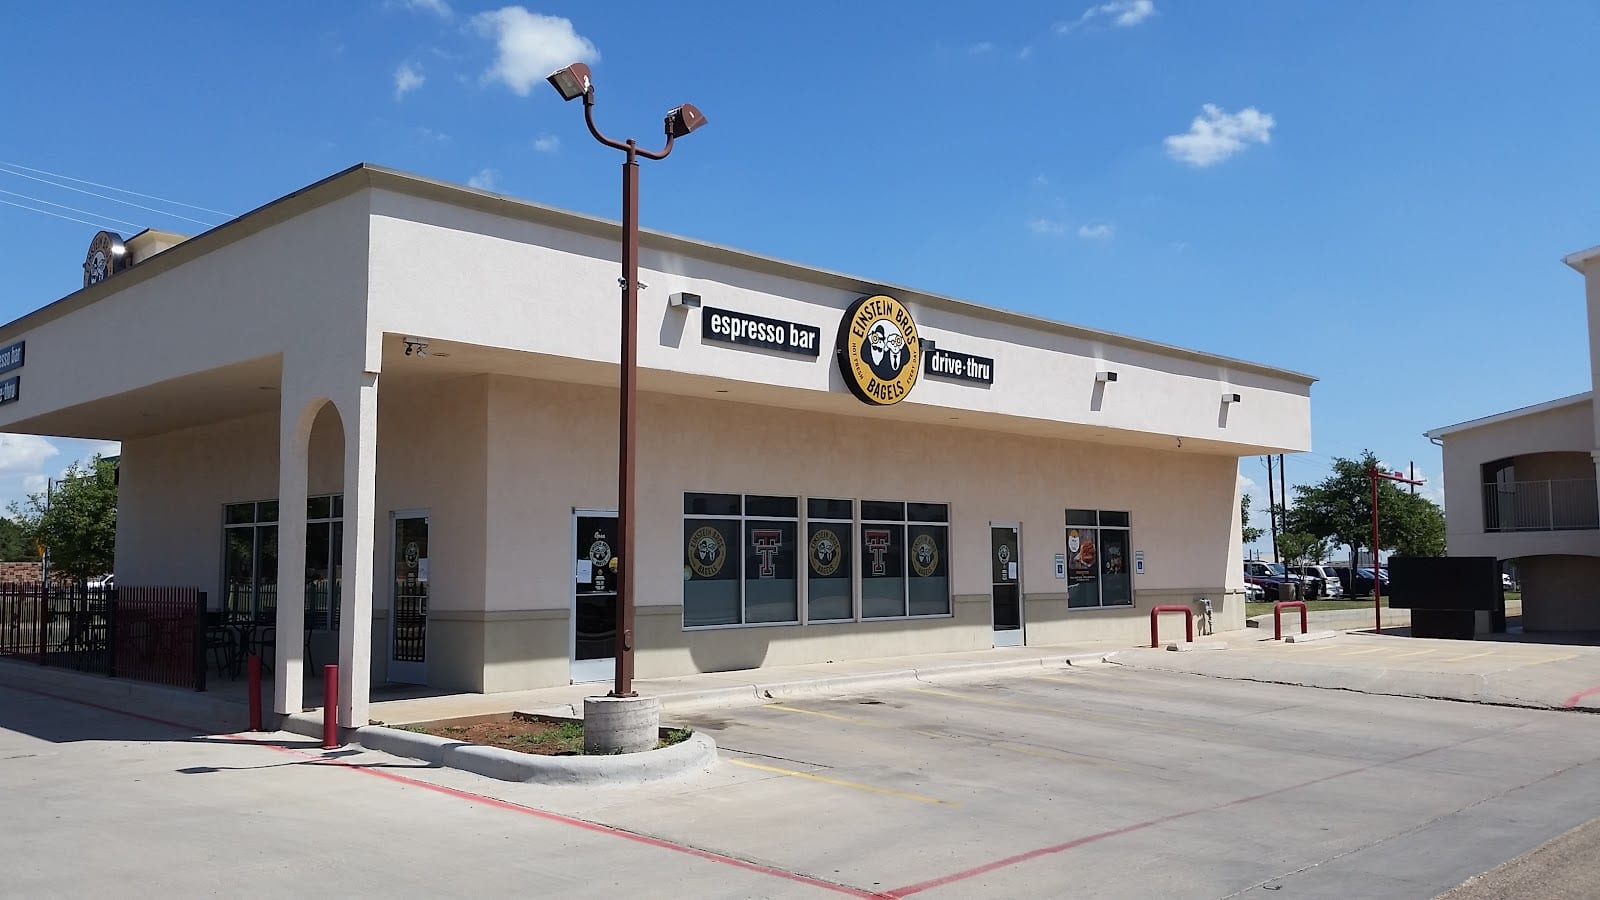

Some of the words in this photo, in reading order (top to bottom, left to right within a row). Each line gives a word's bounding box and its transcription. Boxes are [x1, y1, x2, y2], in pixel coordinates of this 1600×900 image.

[711, 313, 785, 345] espresso
[789, 324, 815, 349] bar
[852, 299, 893, 339] EINSTEIN
[895, 308, 916, 345] BROS
[866, 377, 904, 401] BAGELS
